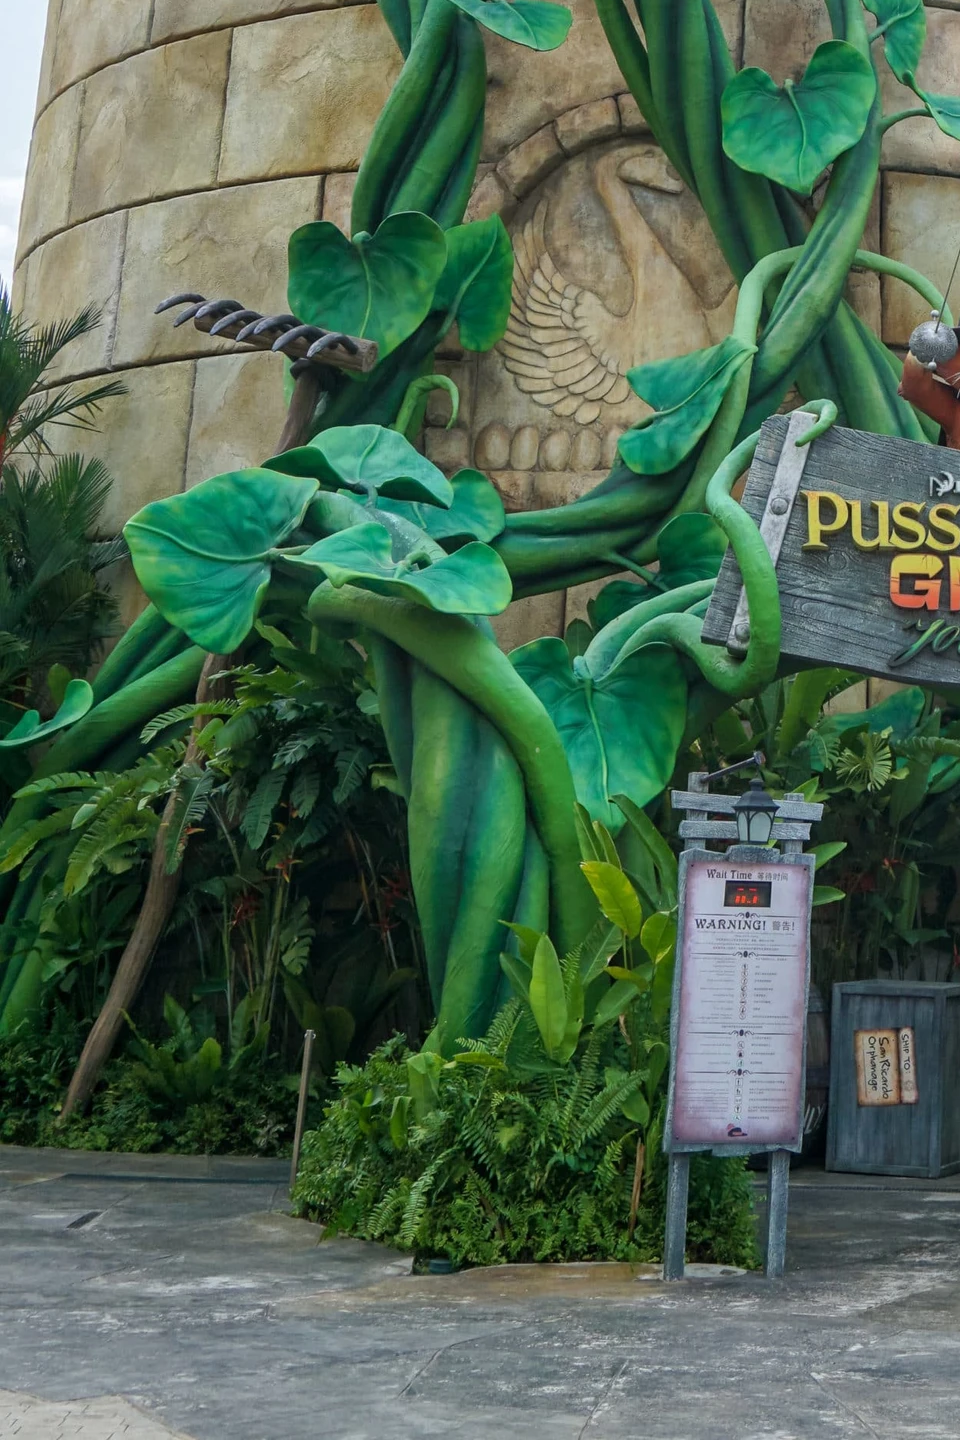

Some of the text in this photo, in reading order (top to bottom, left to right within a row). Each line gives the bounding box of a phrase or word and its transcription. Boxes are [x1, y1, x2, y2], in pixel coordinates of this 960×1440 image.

[706, 869, 728, 880] Wait
[731, 869, 753, 880] Time
[695, 918, 767, 931] WARNING!
[901, 1034, 910, 1054] SHIP
[866, 1036, 878, 1091] Orphanage
[878, 1036, 893, 1100] San Ricardo
